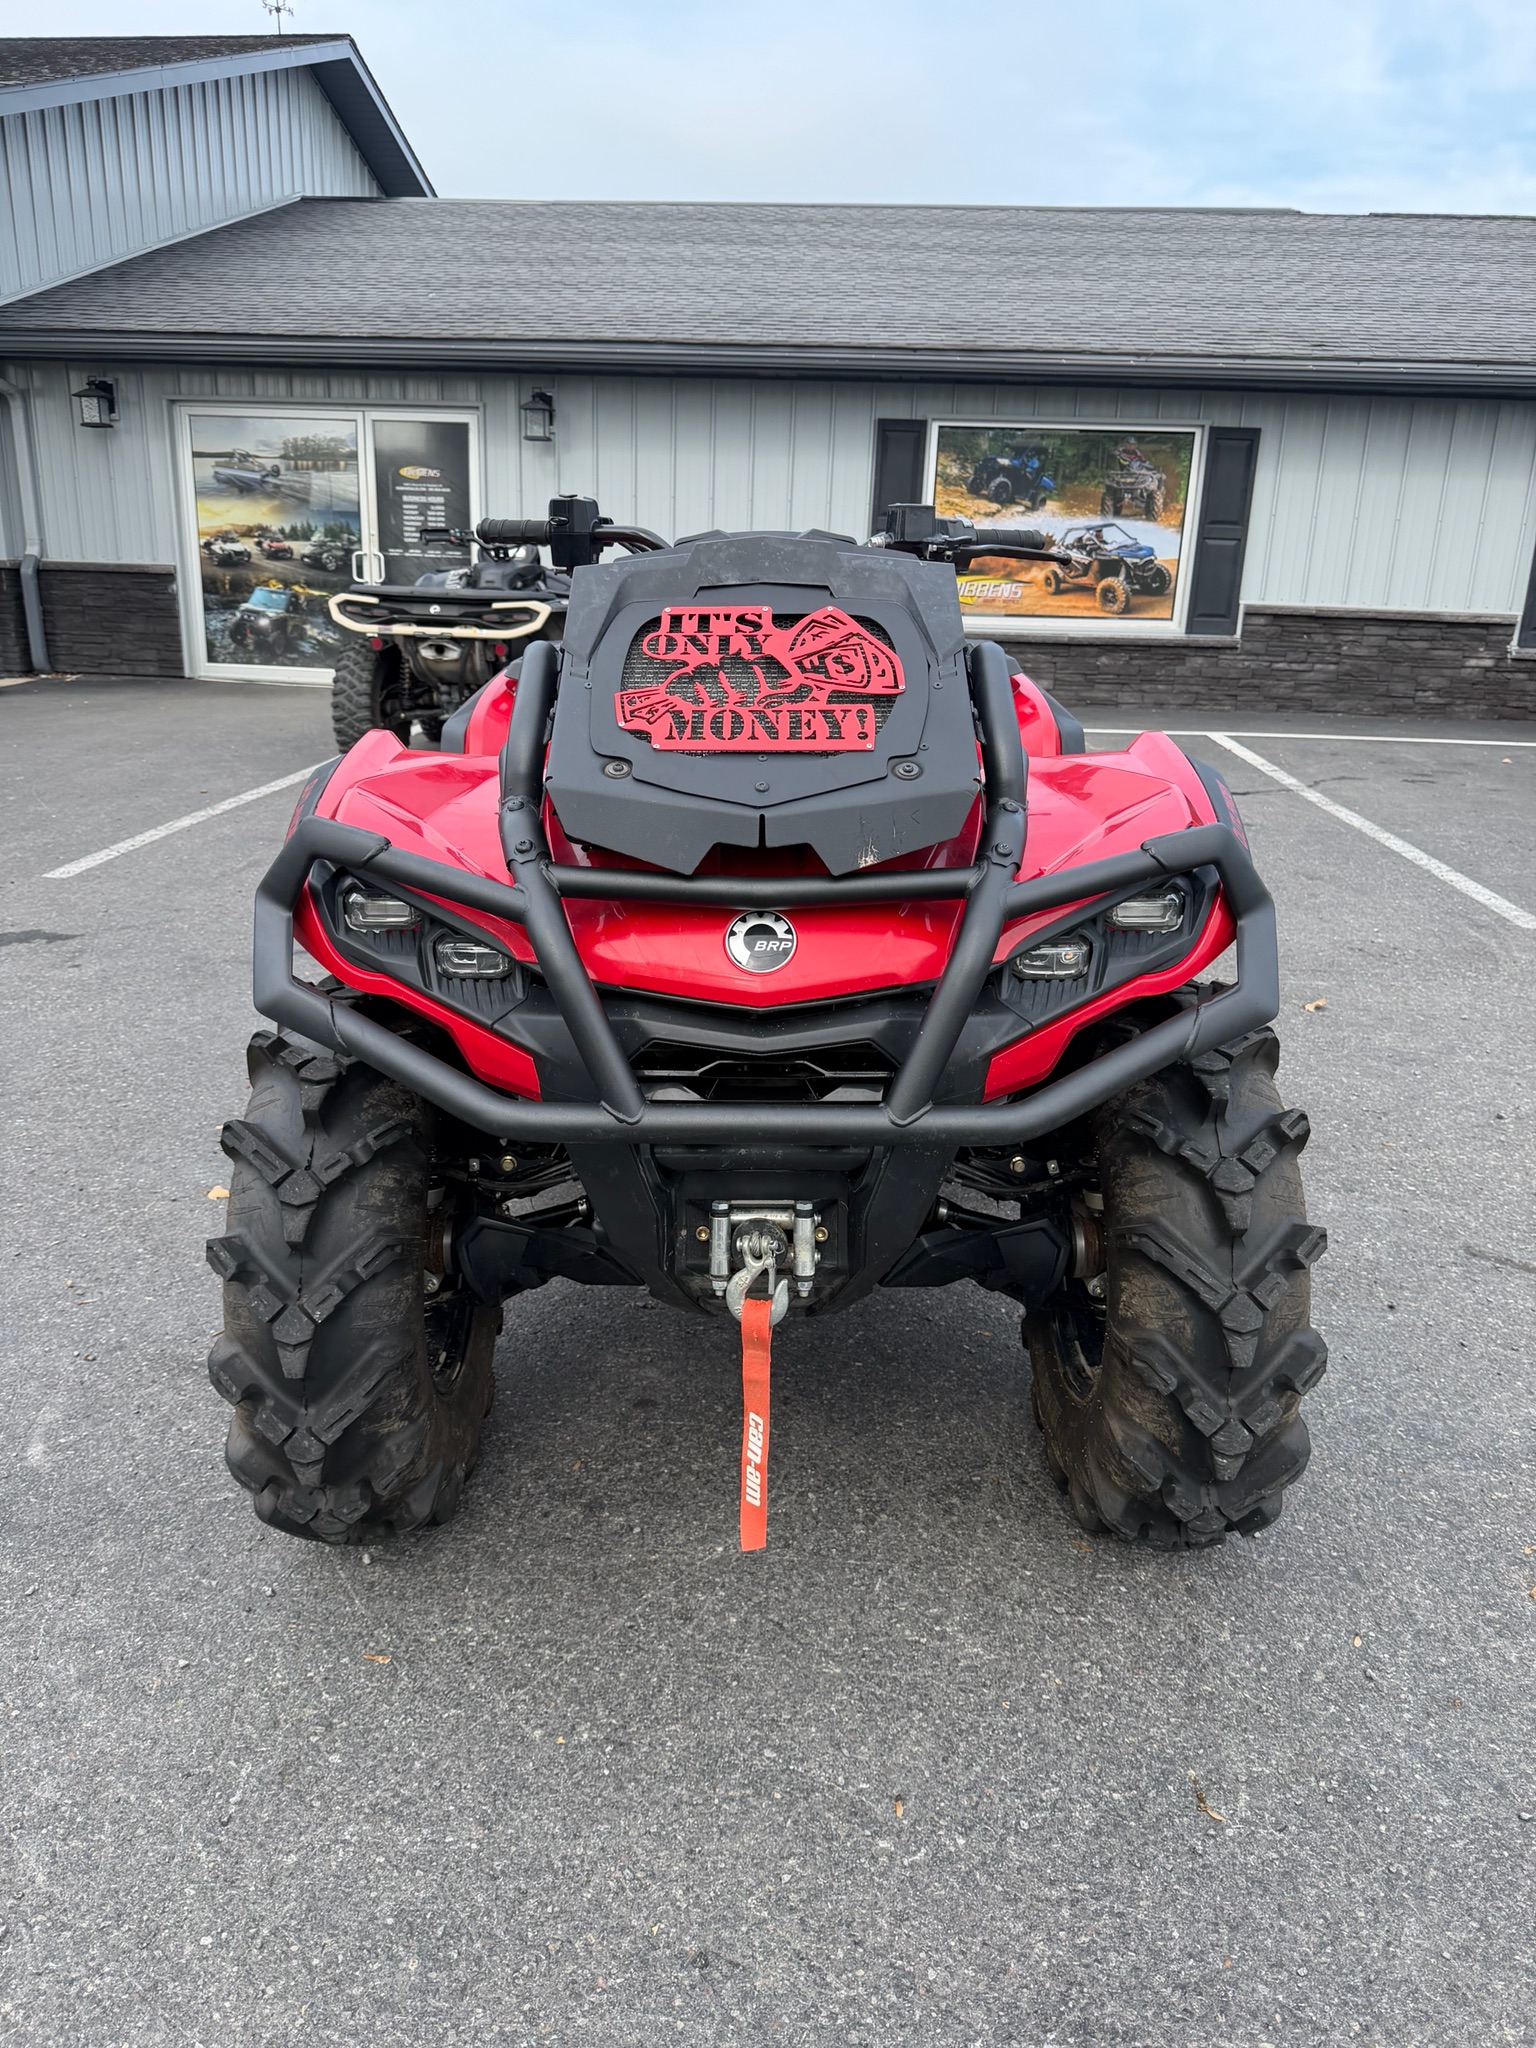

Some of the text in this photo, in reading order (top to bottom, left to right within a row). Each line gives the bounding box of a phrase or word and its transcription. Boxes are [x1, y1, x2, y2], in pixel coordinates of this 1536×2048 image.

[665, 612, 763, 634] IT'S
[643, 633, 773, 656] ONLY
[664, 708, 869, 741] MONEY!
[754, 940, 793, 952] BRP
